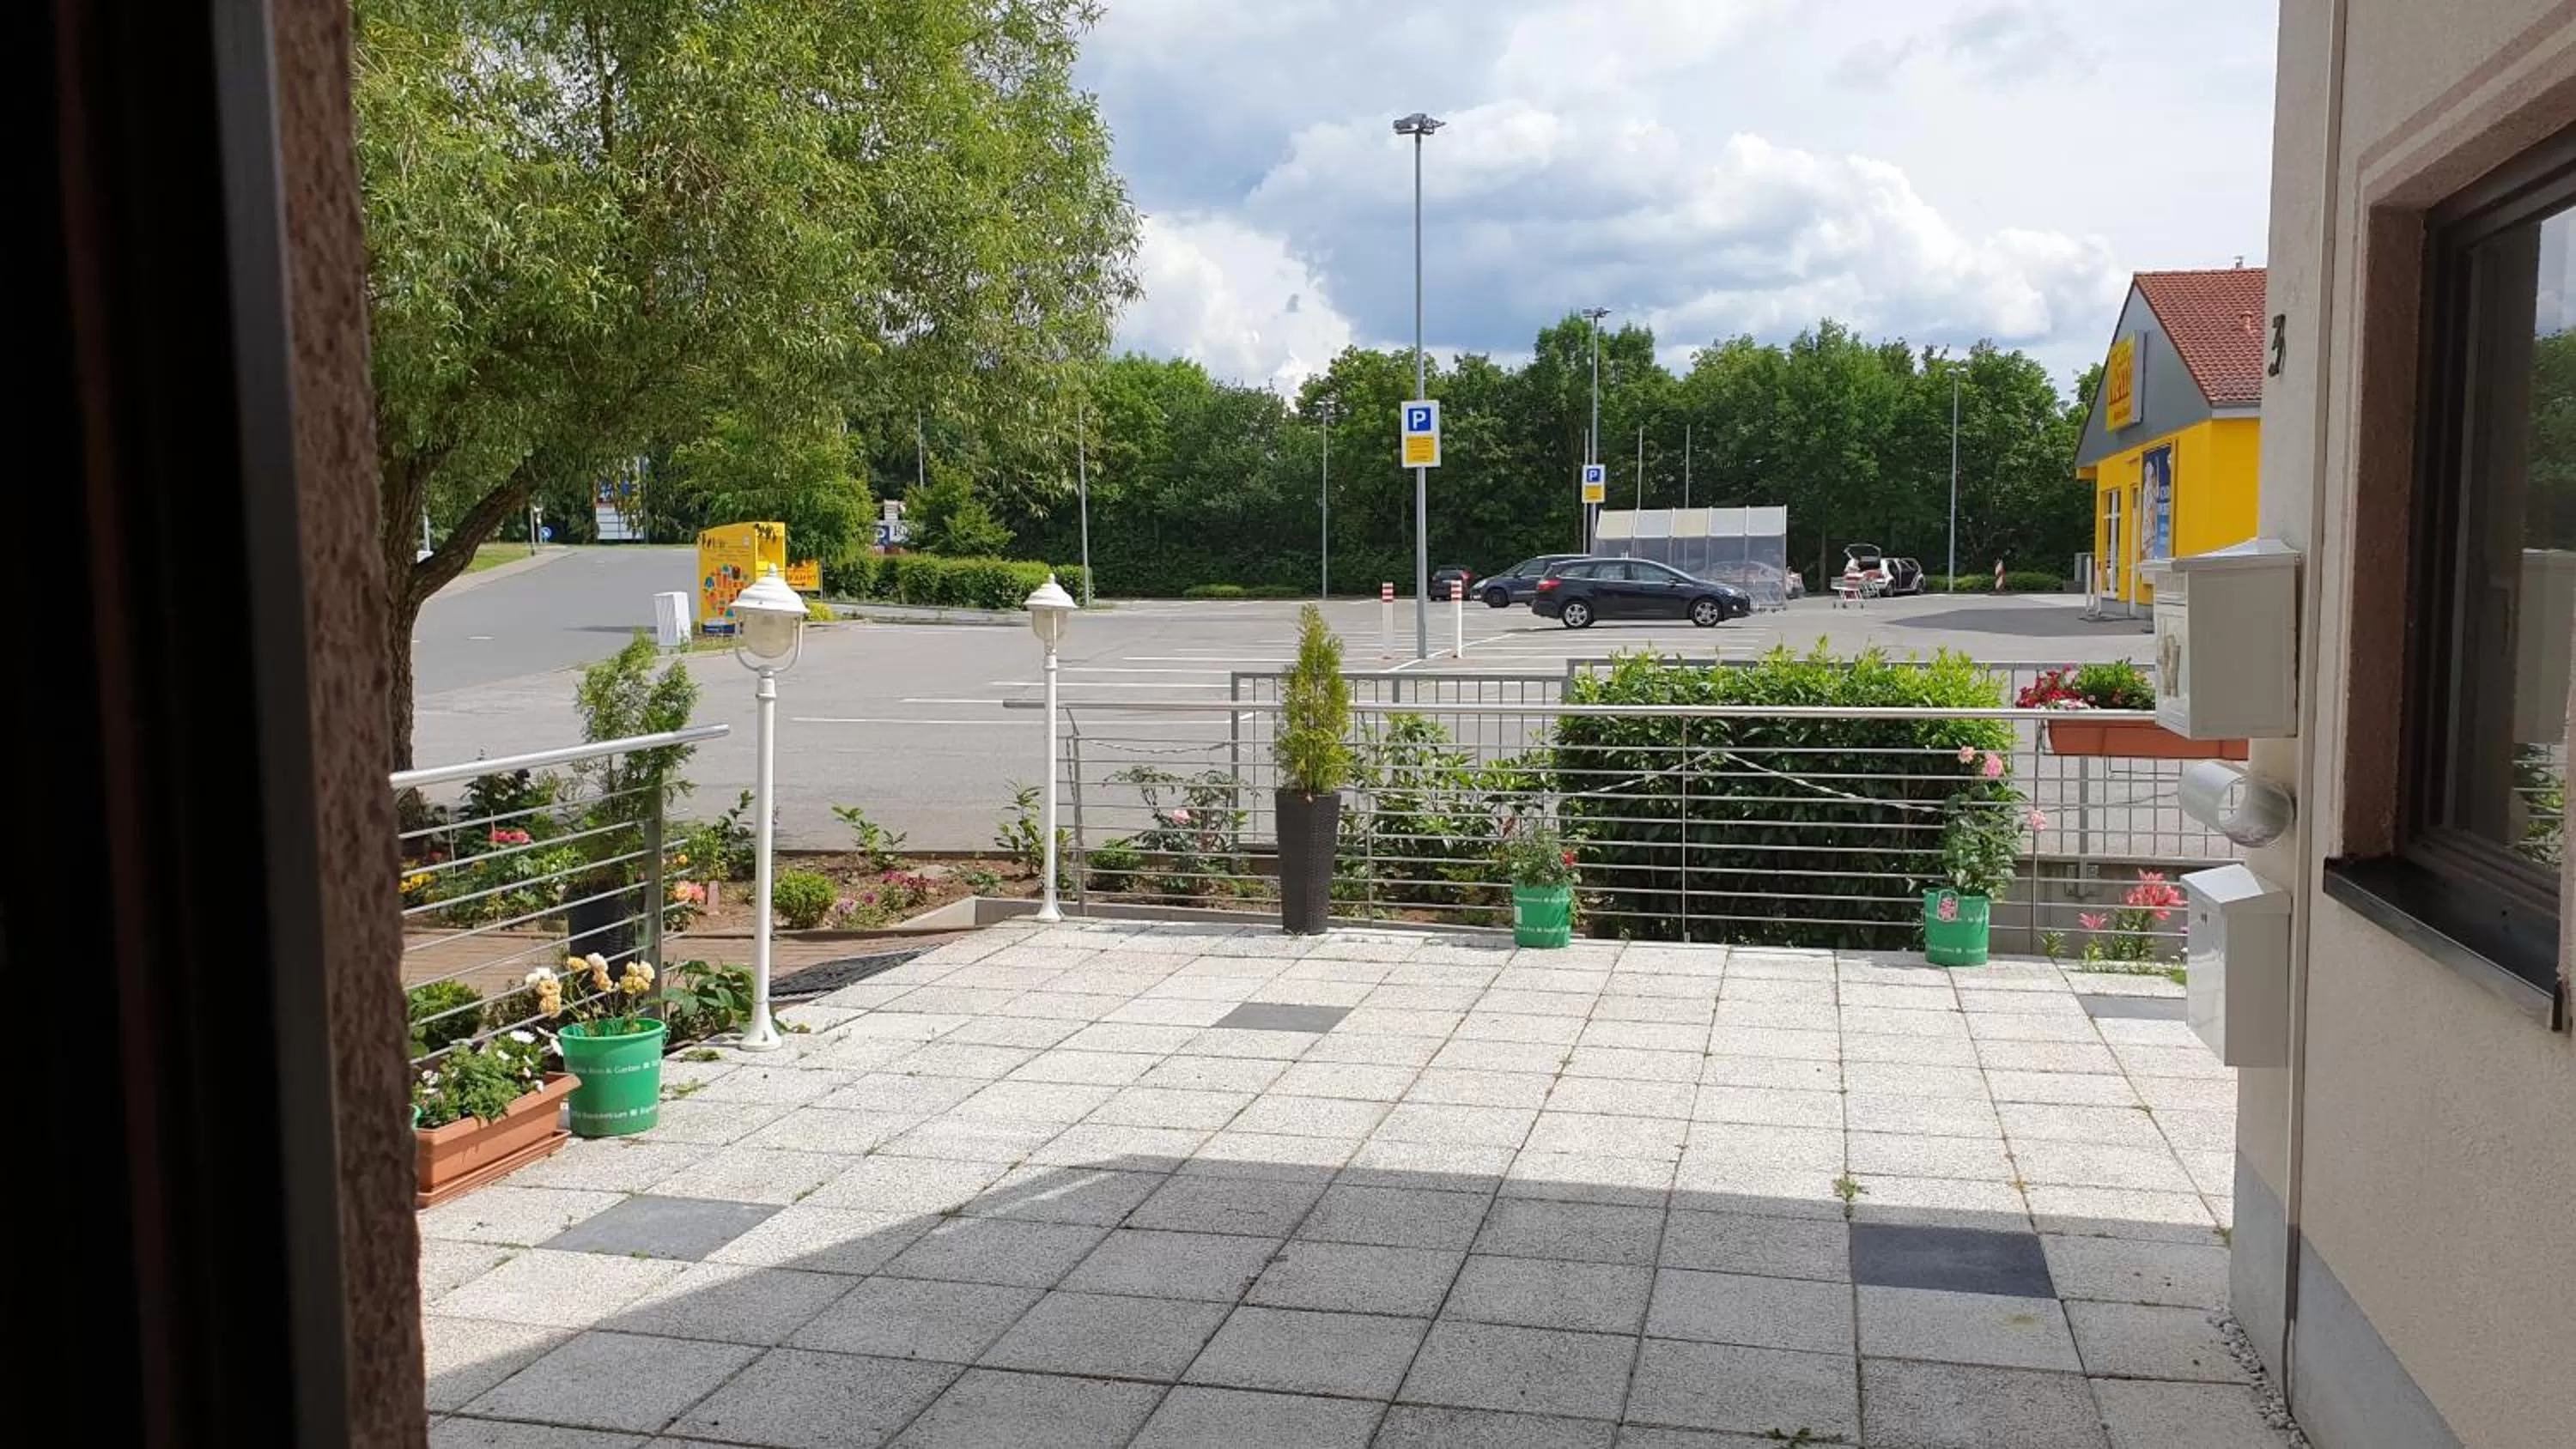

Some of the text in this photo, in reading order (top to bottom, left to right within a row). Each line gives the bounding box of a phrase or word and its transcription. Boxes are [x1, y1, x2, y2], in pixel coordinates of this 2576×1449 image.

[2268, 313, 2286, 377] 3
[1413, 409, 1426, 429] P
[1589, 470, 1598, 481] P
